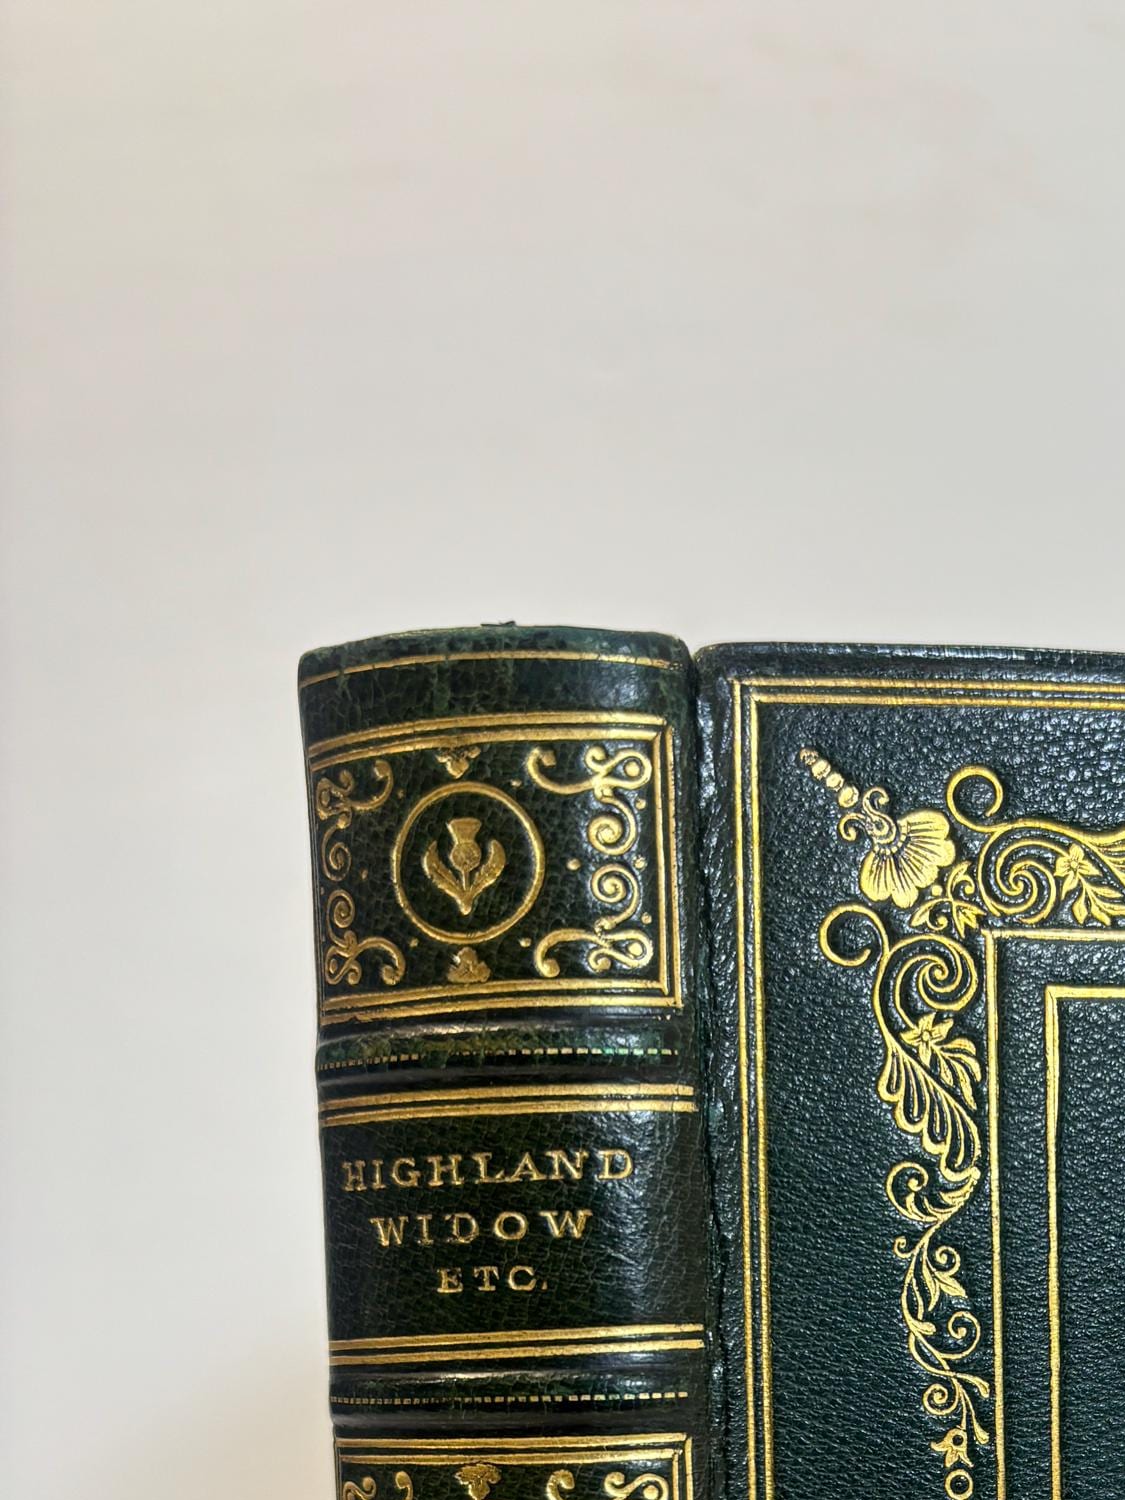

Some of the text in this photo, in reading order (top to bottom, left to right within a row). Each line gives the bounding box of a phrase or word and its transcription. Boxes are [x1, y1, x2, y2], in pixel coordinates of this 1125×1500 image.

[342, 1148, 635, 1191] HIGHLAND
[370, 1209, 593, 1247] WIDOW
[436, 1265, 548, 1293] ETC.
